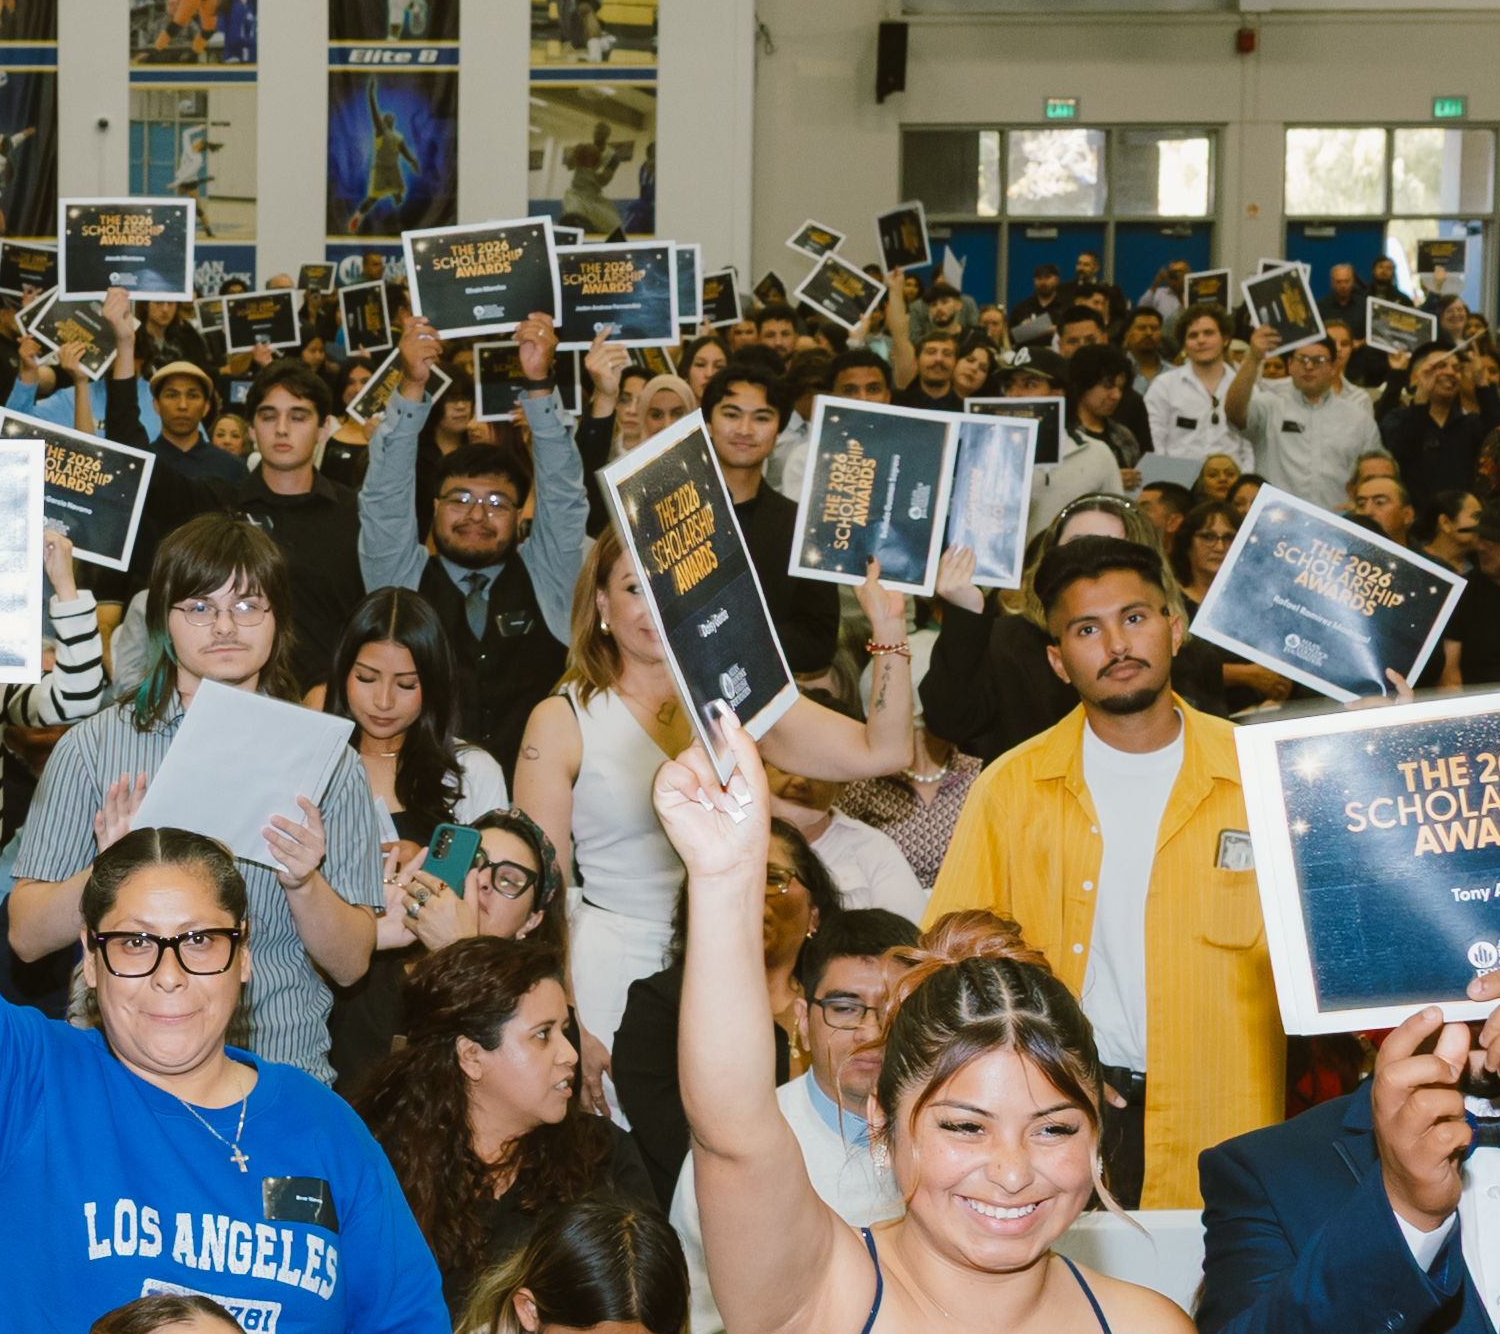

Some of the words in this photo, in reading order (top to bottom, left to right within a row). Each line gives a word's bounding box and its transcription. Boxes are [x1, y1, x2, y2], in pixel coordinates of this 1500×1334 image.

[349, 49, 412, 63] Elite
[81, 225, 165, 236] SCHOLARSHIP
[100, 215, 121, 225] THE
[123, 215, 153, 225] 2026
[99, 235, 152, 246] AWARDS
[450, 244, 475, 255] THE
[477, 240, 509, 253] 2026
[432, 248, 523, 270] SCHOLARSHIP
[455, 262, 512, 279] AWARDS
[580, 262, 602, 273] THE
[603, 261, 634, 272] 2026
[563, 270, 645, 285] SCHOLARSHIP
[582, 281, 633, 295] AWARDS
[67, 452, 101, 472] 2026
[829, 453, 848, 491] 2026
[834, 440, 864, 550] SCHOLARSHIP
[851, 459, 877, 526] AWARDS
[655, 496, 676, 532] THE
[674, 480, 700, 520] 2026
[823, 493, 841, 522] THE
[651, 504, 715, 574] SCHOLARSHIP
[673, 541, 718, 595] AWARDS
[1274, 542, 1403, 608] SCHOLARSHIP
[1309, 538, 1346, 566] THE
[1345, 556, 1392, 588] 2026
[1294, 570, 1378, 617] AWARDS
[1397, 755, 1470, 792] THE
[1451, 887, 1491, 902] Tony
[84, 1198, 162, 1260] LOS
[171, 1212, 338, 1301] ANGELES
